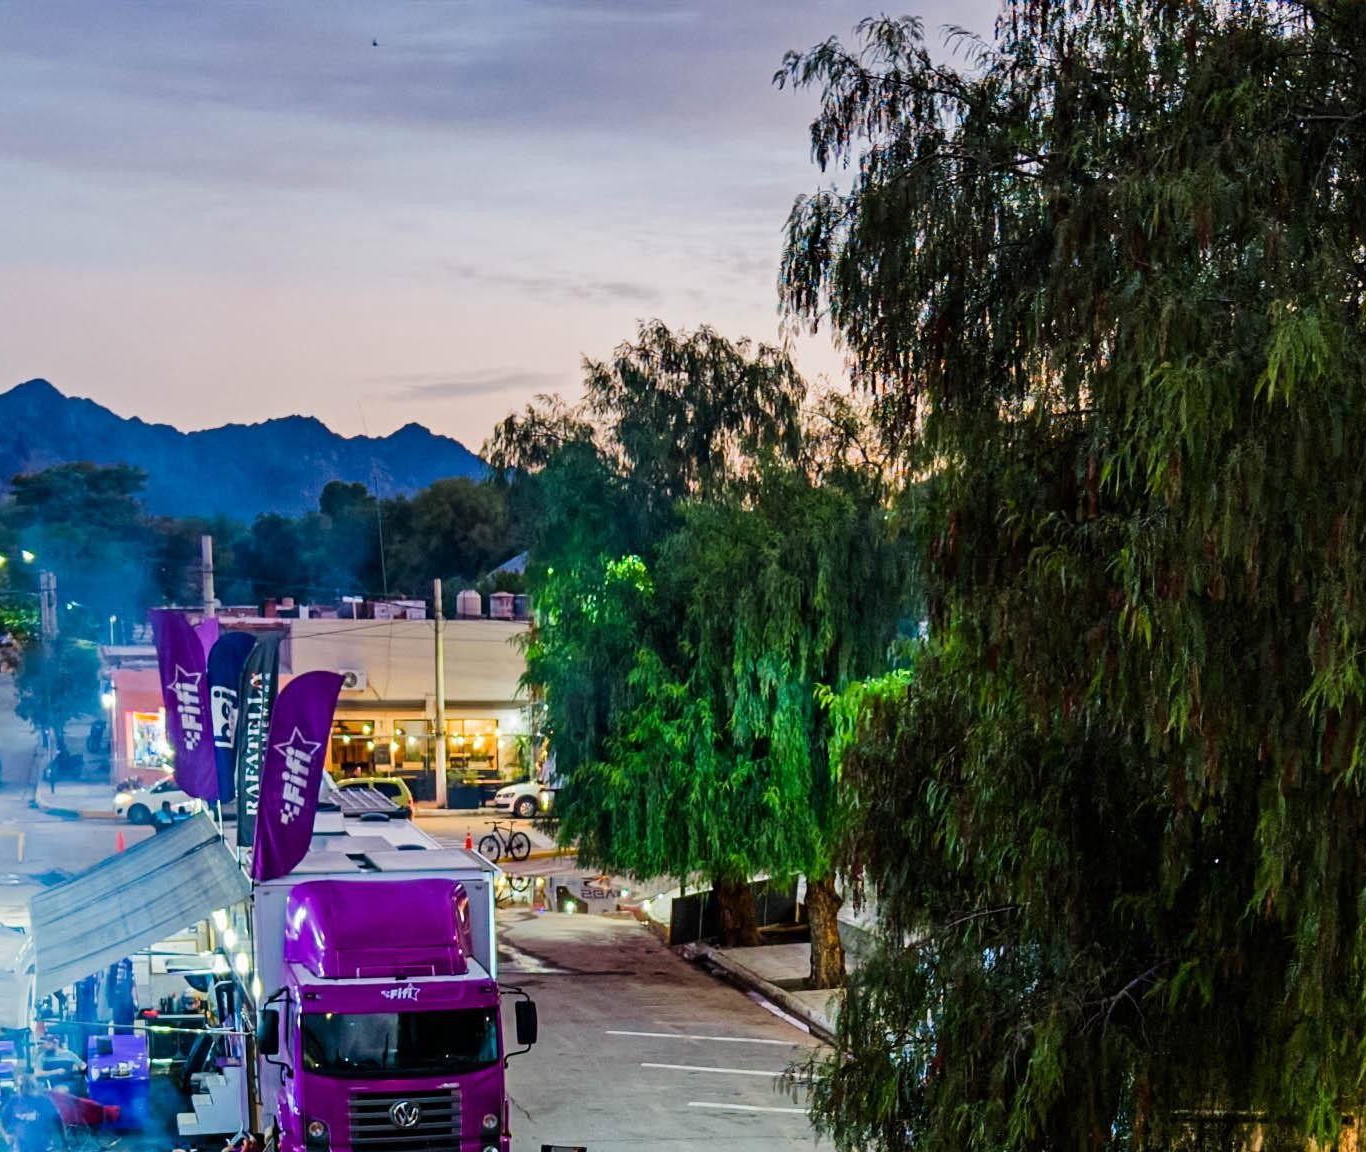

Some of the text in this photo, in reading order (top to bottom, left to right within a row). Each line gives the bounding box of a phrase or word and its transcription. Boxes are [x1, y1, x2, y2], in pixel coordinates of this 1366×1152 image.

[176, 682, 203, 736] Fifi
[213, 687, 239, 744] bcj
[245, 673, 264, 816] RAFATELLA
[282, 746, 314, 816] Fifi
[390, 988, 413, 1000] Fifi
